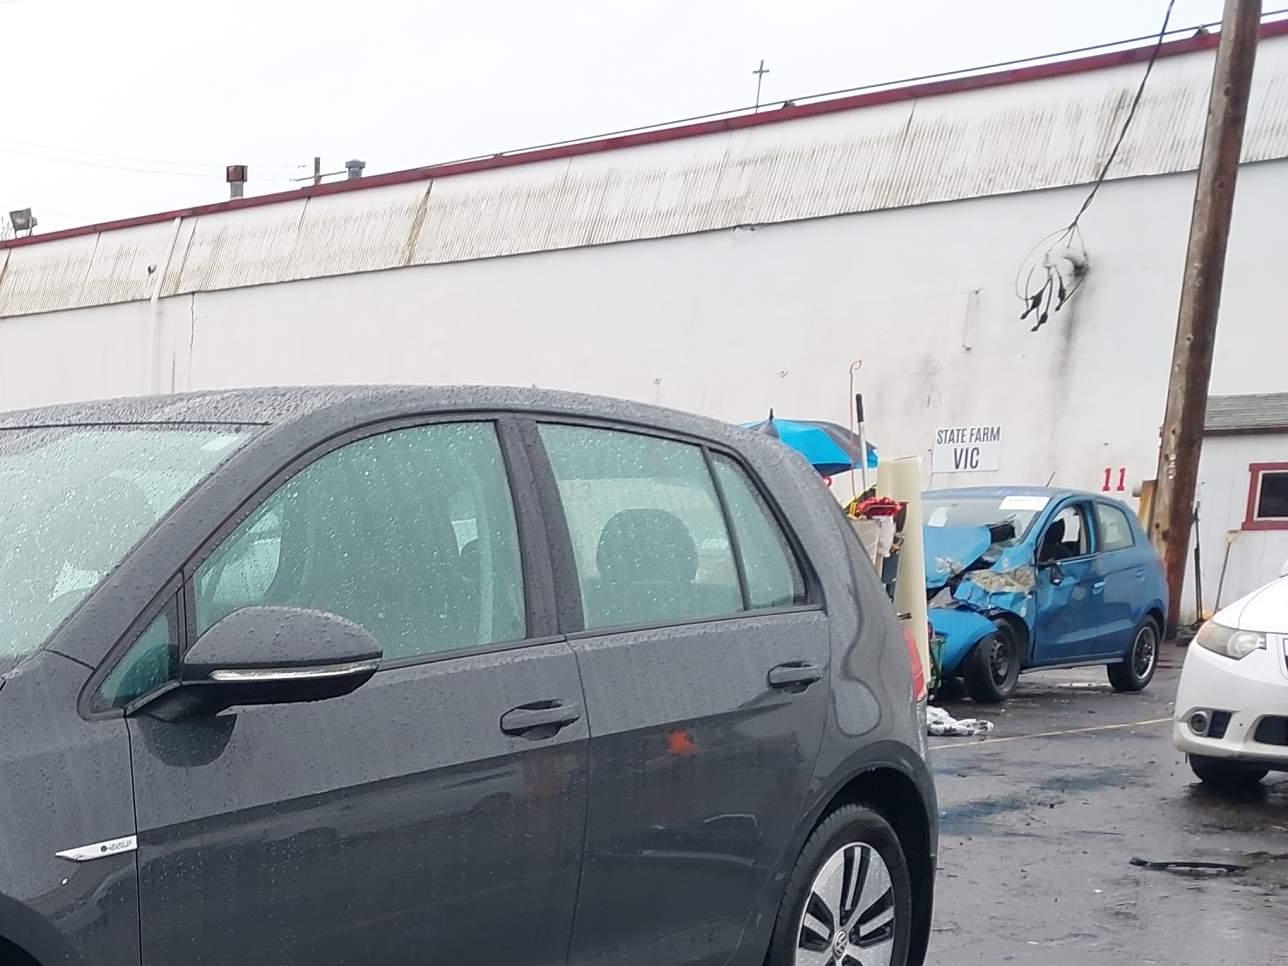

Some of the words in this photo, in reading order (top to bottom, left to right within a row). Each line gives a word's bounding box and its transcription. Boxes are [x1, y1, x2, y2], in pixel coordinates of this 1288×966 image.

[936, 428, 967, 445] STATE
[969, 426, 1001, 443] FARM
[953, 447, 980, 470] VIC
[1102, 467, 1127, 492] 11
